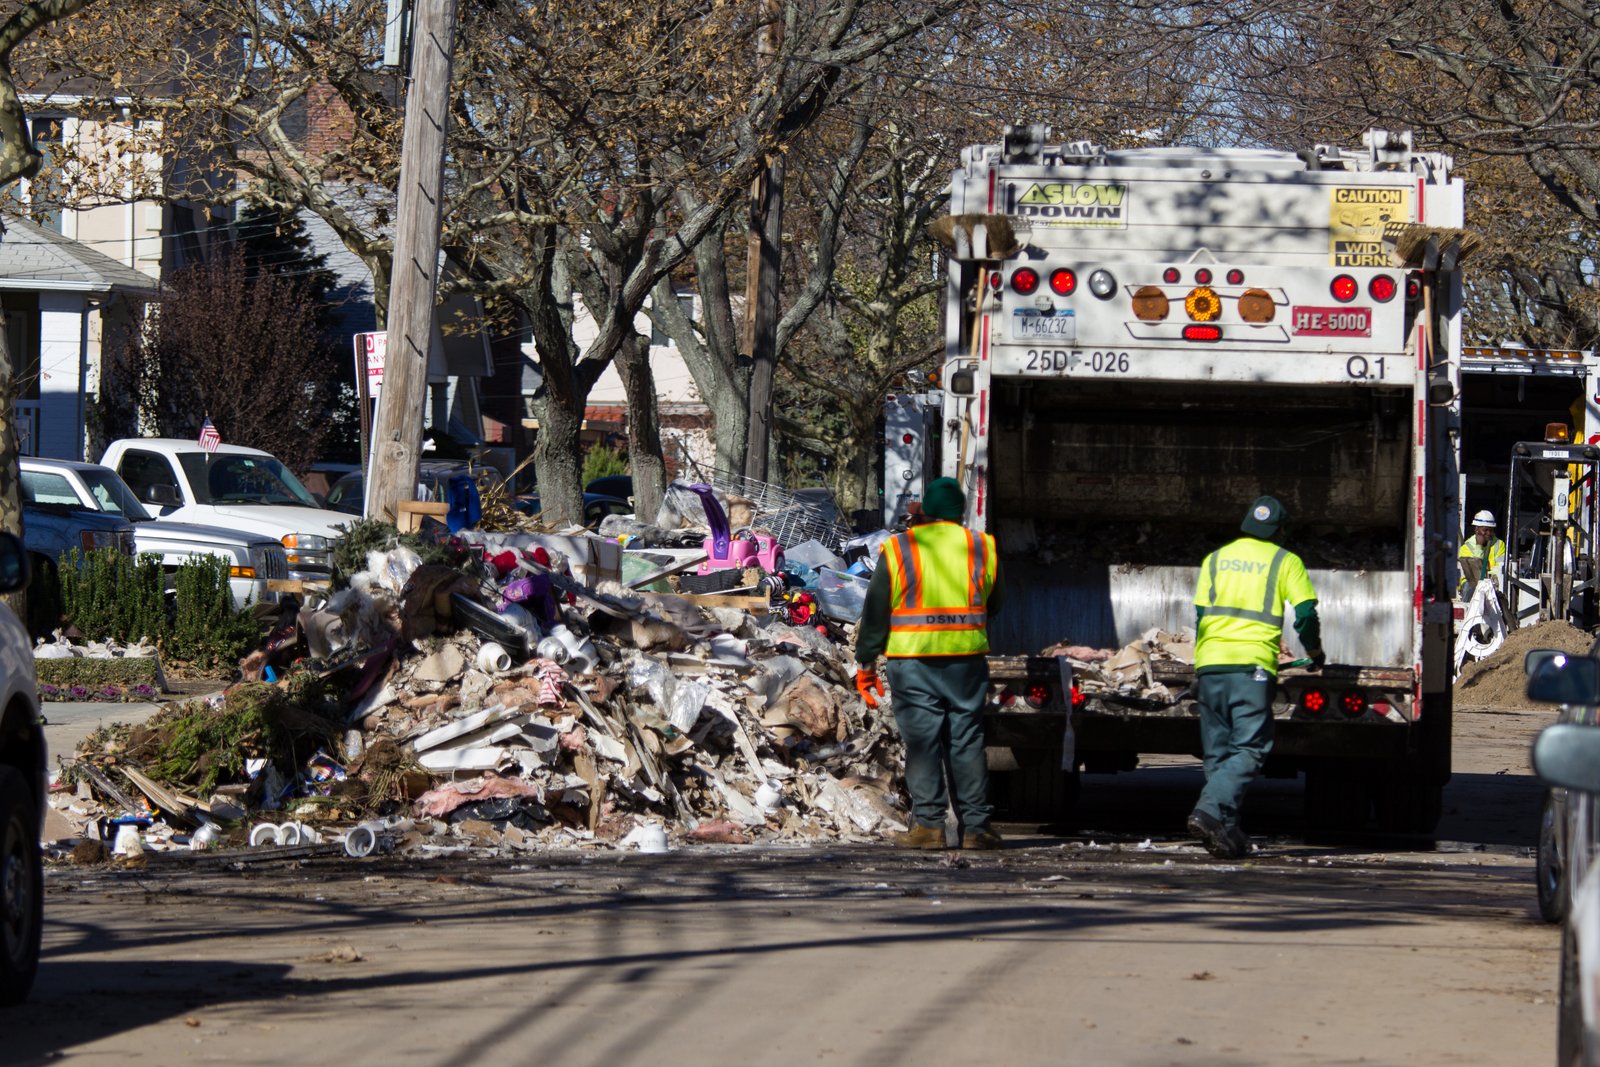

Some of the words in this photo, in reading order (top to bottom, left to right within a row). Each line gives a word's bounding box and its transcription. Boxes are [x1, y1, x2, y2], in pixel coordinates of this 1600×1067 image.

[1042, 183, 1125, 206] SLOW
[1337, 190, 1400, 203] CAUTION
[1018, 205, 1120, 218] DOWN
[1296, 312, 1367, 331] HE-5000
[1026, 350, 1129, 373] 25DF-026
[1346, 355, 1385, 380] Q.1
[1218, 559, 1268, 575] DSNY
[926, 615, 967, 624] DSNY
